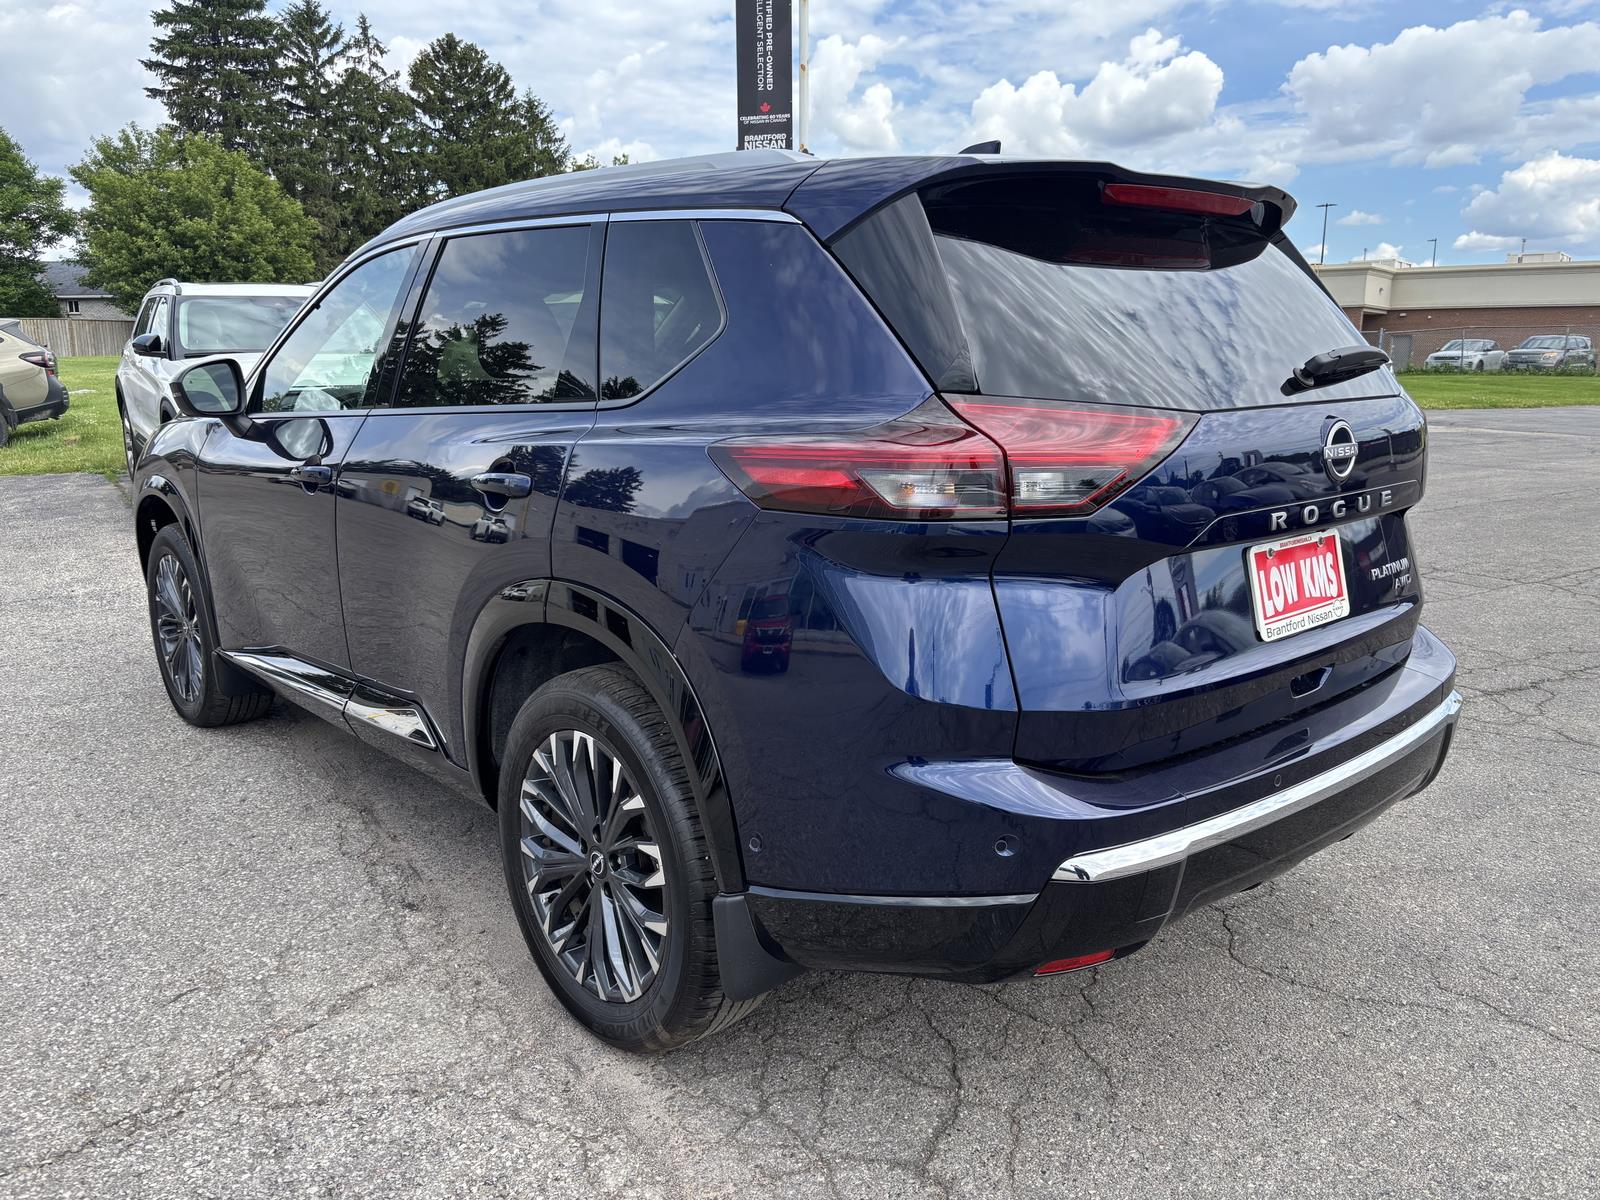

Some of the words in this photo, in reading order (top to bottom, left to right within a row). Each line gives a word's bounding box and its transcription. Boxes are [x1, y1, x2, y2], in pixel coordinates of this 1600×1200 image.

[766, 32, 774, 91] PRE-OWNED
[744, 133, 787, 142] BRANTFORD
[744, 139, 786, 150] NISSAN
[1325, 445, 1358, 459] NISSAN
[1270, 490, 1393, 531] ROGUE
[1371, 557, 1409, 581] PLATINUM
[1259, 561, 1298, 617] LOW
[1300, 552, 1338, 598] KMS
[1395, 573, 1411, 590] AWD
[1266, 617, 1306, 639] Brantford
[1307, 610, 1333, 626] Nissan
